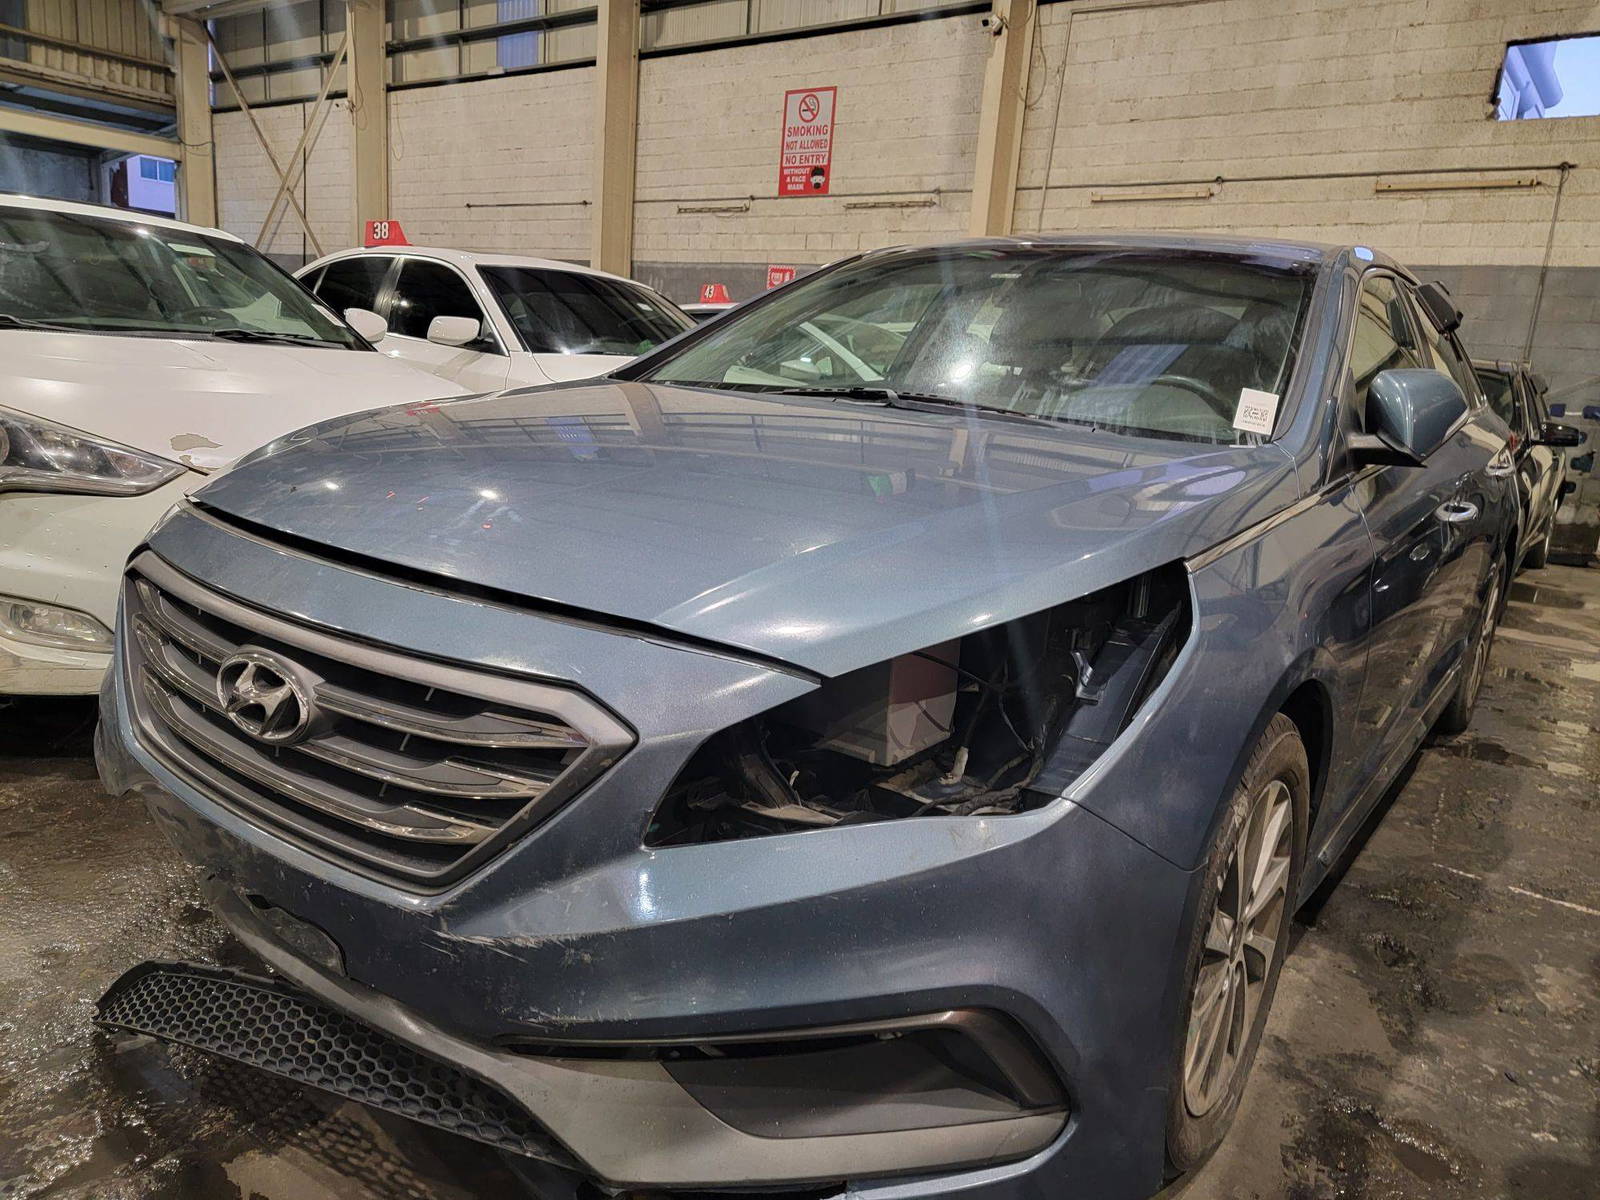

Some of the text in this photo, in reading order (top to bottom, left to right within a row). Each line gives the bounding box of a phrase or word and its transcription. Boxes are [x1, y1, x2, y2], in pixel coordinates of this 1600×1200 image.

[787, 125, 828, 137] SMOKING
[786, 139, 828, 150] NOT ALLOWED
[785, 154, 826, 165] NO ENTRY
[374, 222, 389, 239] 38
[704, 285, 715, 298] 43
